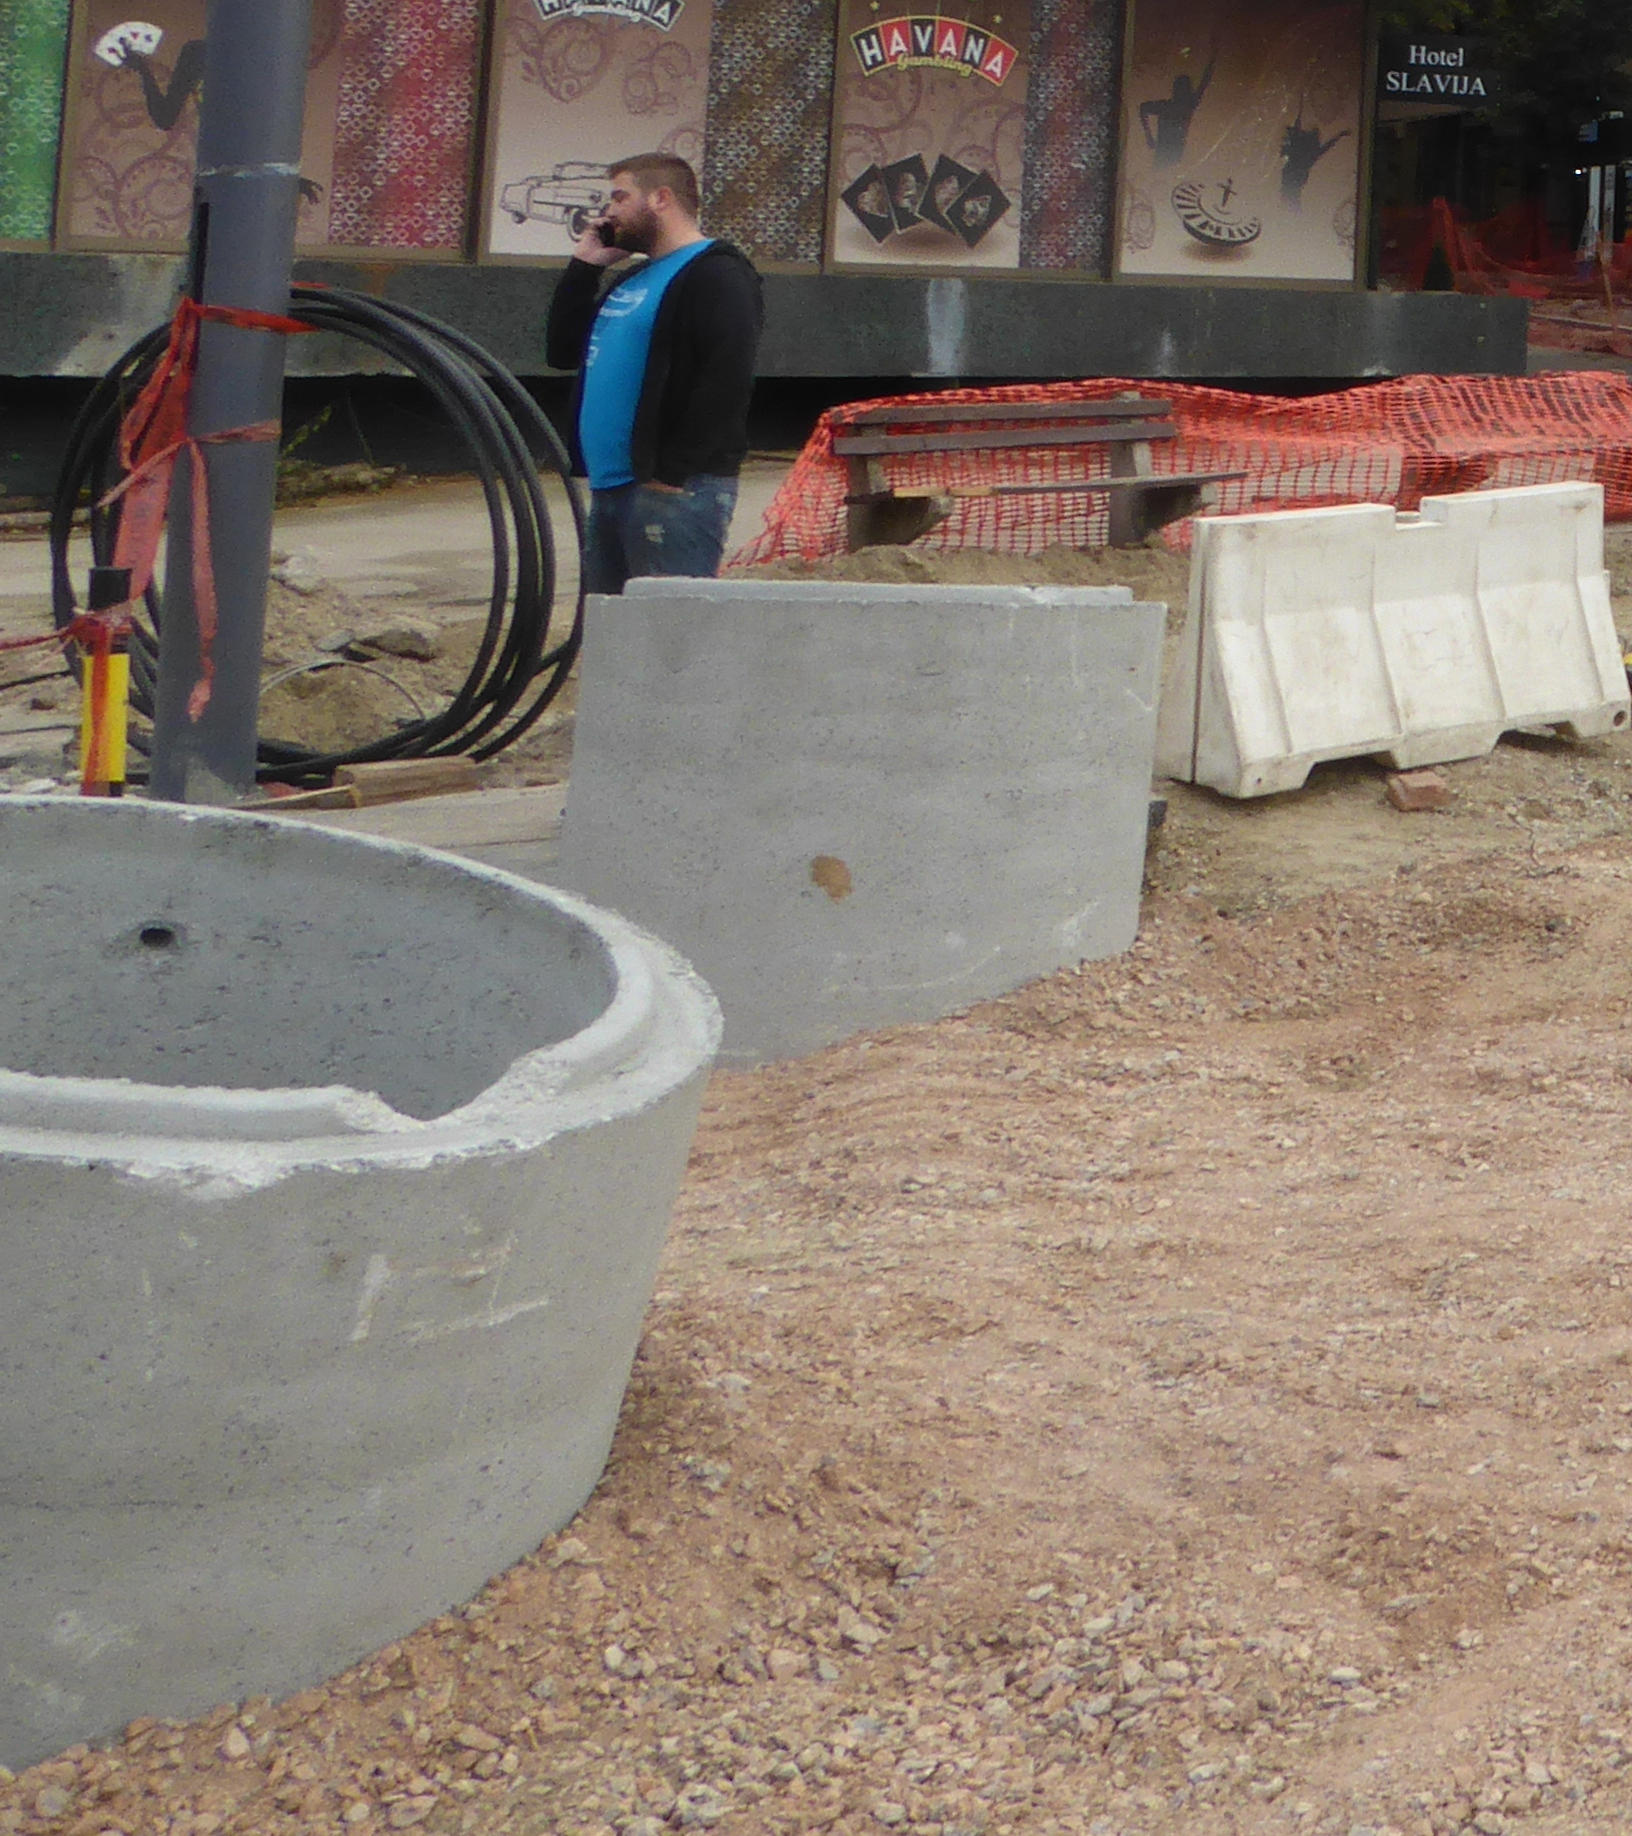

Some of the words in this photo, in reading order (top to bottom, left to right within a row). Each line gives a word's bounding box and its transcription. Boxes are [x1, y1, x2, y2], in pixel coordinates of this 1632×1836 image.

[859, 24, 1005, 79] HAVANA
[1408, 44, 1464, 67] Hotel
[1385, 69, 1487, 96] SLAVIJA
